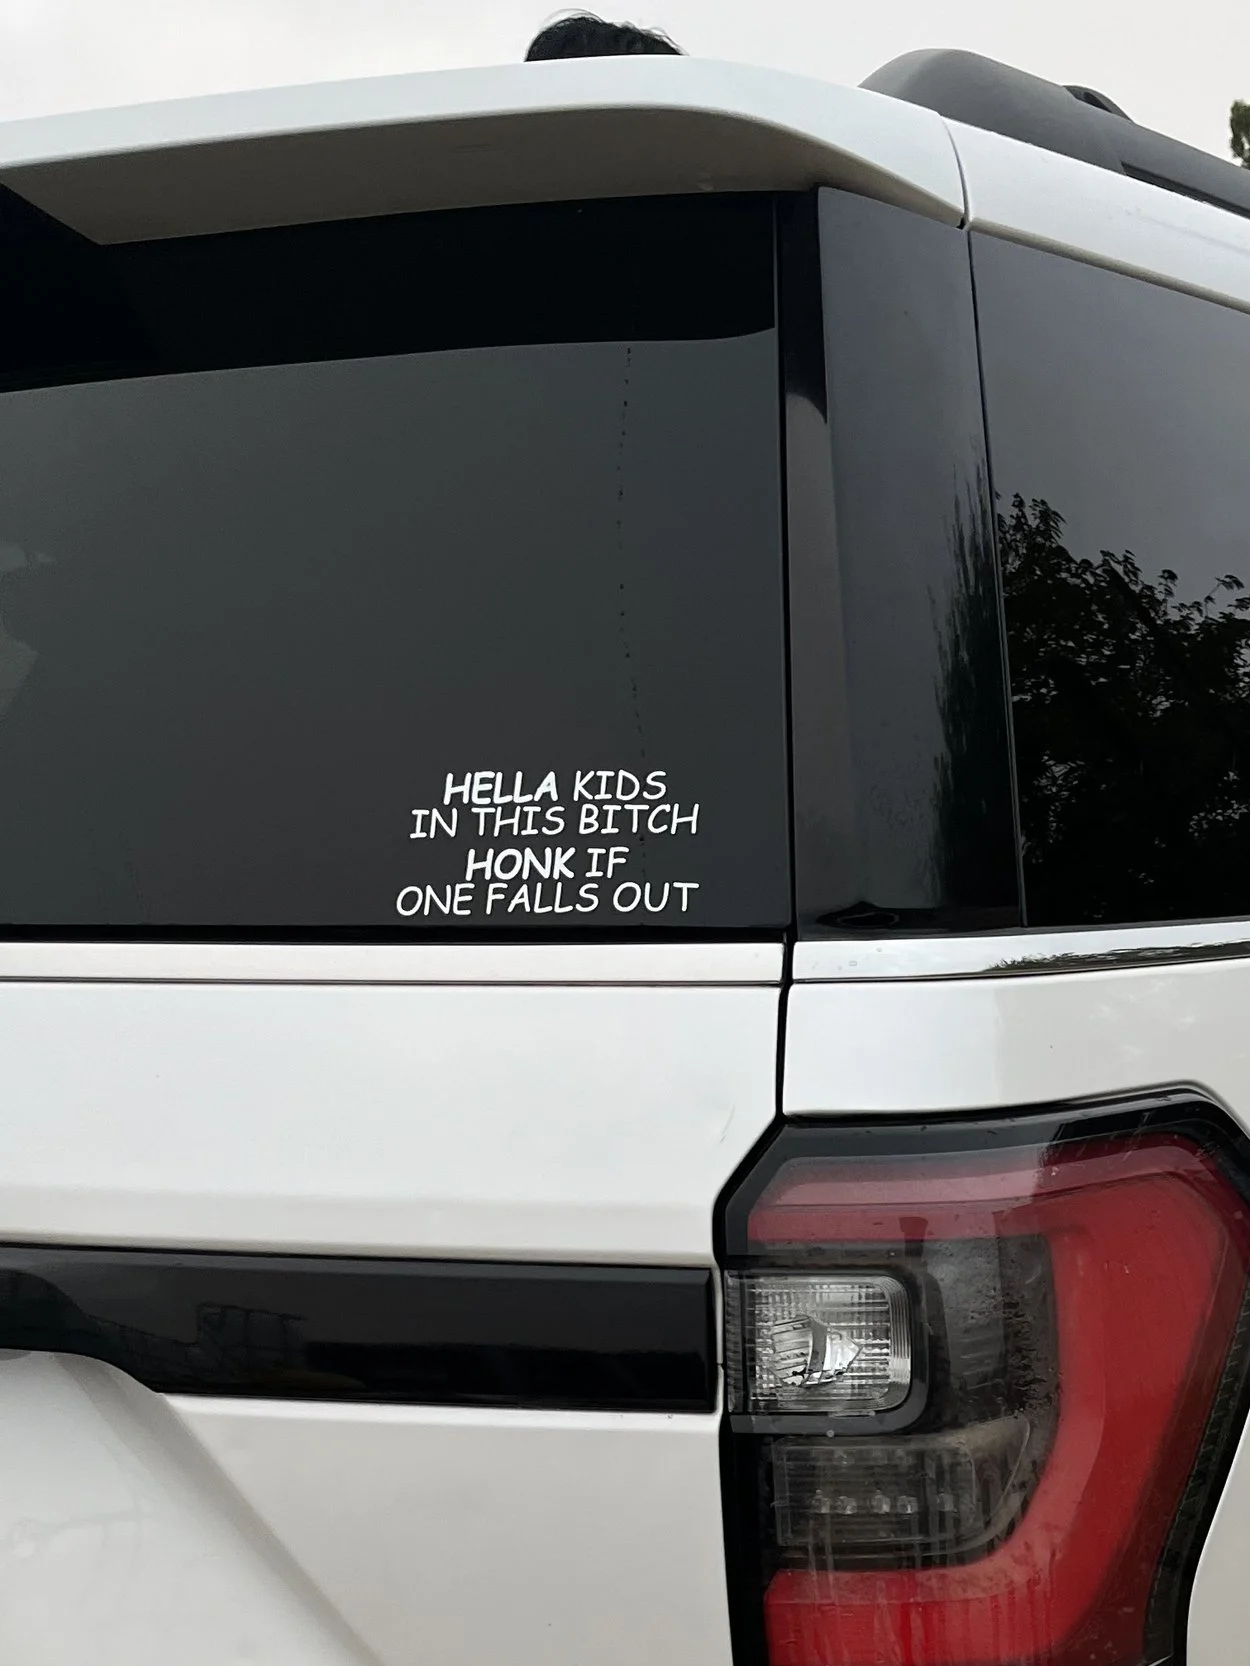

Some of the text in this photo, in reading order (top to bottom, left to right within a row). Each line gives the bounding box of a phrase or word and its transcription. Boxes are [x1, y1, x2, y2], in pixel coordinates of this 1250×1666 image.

[444, 770, 667, 805] HELLA KIDS
[410, 803, 699, 839] IN THIS BITCH
[465, 847, 630, 881] HONK IF
[396, 881, 700, 916] ONE FALLS OUT
